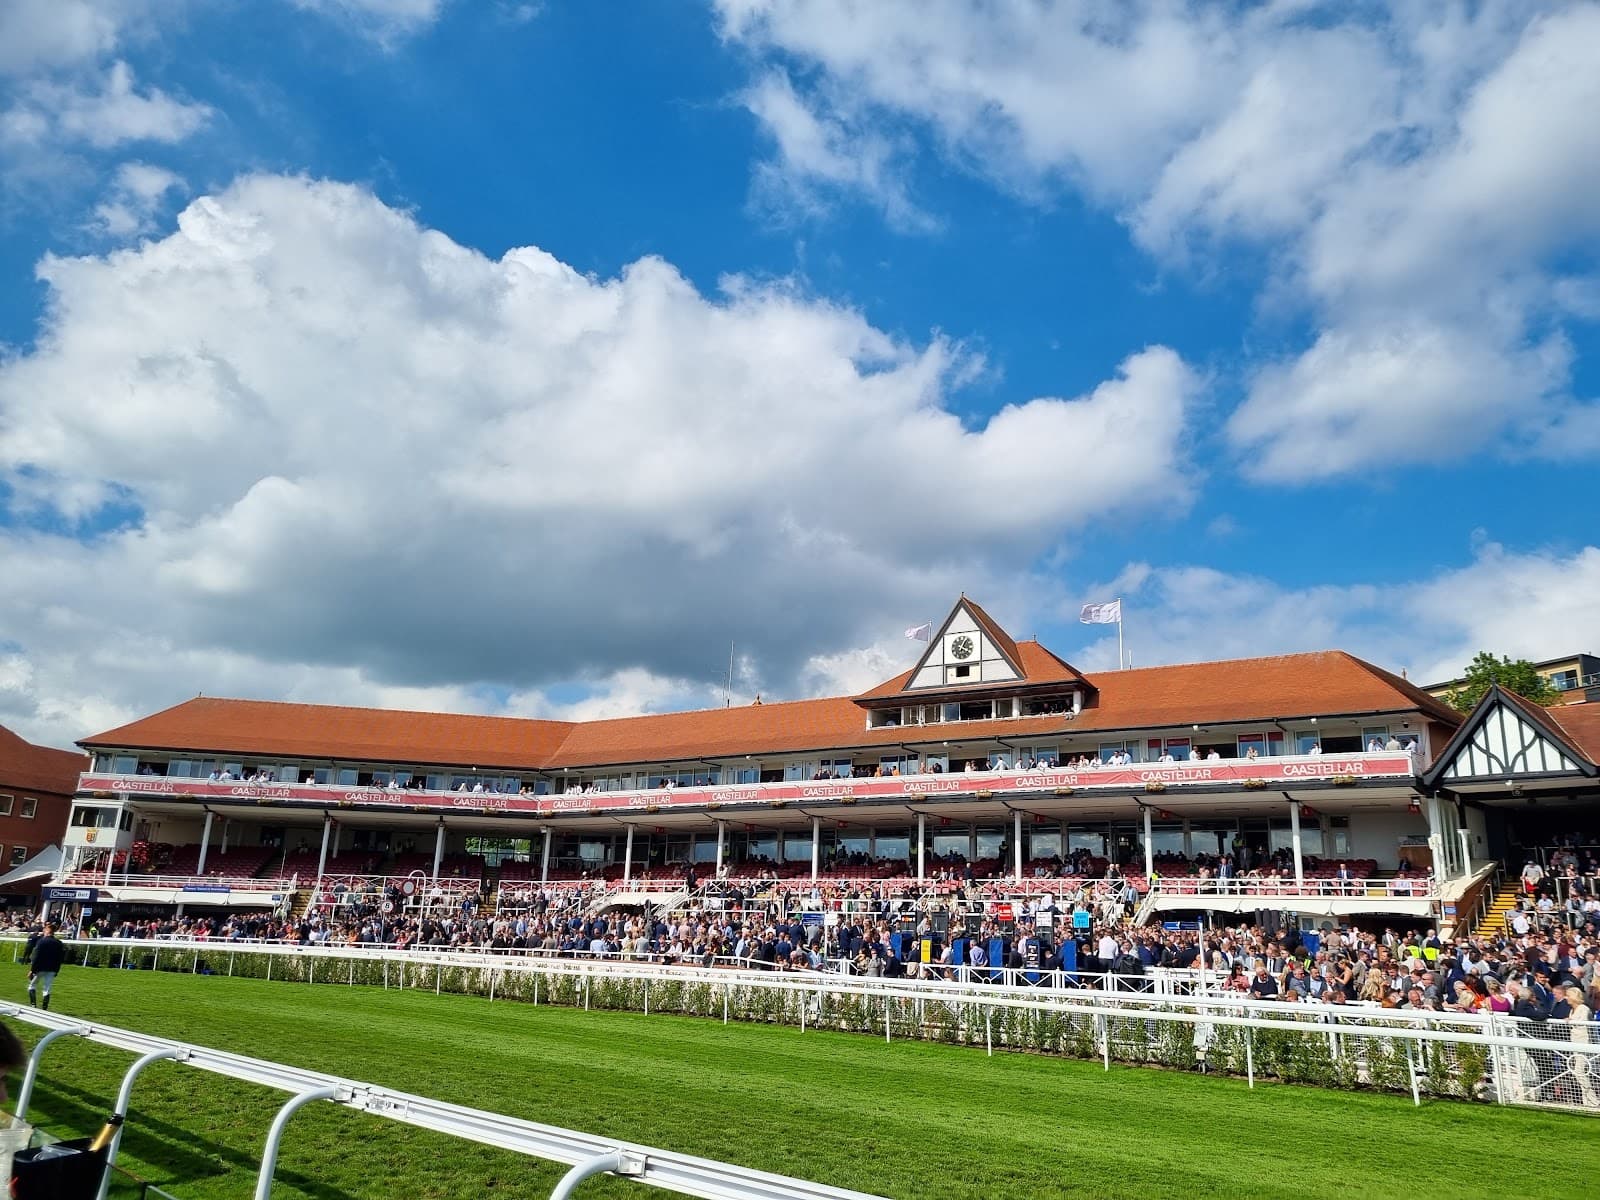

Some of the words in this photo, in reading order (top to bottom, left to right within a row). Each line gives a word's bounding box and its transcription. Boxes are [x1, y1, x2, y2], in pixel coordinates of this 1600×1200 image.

[1283, 762, 1364, 776] CAASTELLAR
[1015, 775, 1078, 787] CAASTELLAR
[1140, 769, 1211, 782] CAASTELLAR
[112, 780, 173, 792] CAASTELLAR
[231, 786, 290, 798] CAASTELLAR
[803, 786, 854, 797] CAASTELLAR
[904, 781, 960, 793] CAASTELLAR
[344, 792, 401, 803] CAASTELLAR
[712, 790, 758, 801] CAASTELLAR
[453, 797, 507, 808] CAASTELLAR
